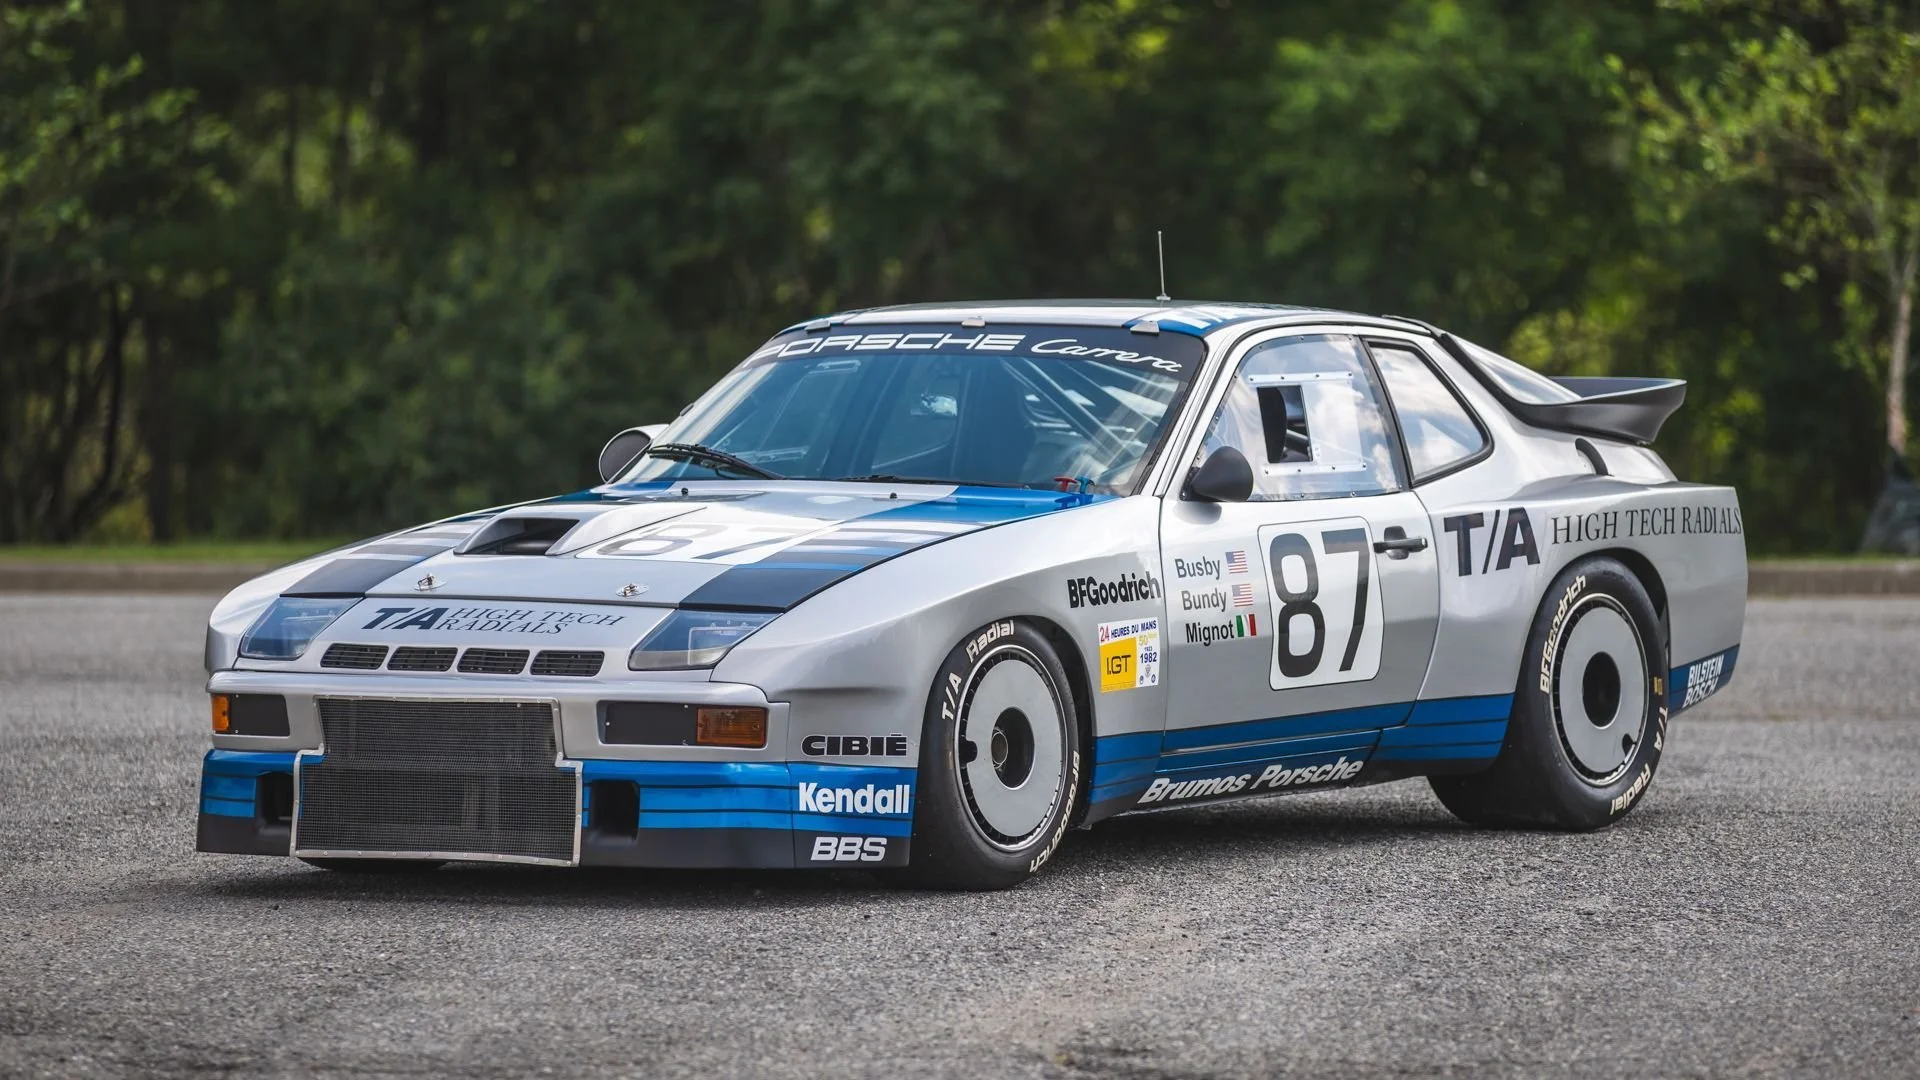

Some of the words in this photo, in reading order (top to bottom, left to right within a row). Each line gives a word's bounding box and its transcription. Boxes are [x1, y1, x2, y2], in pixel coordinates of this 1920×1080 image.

[743, 333, 1025, 368] PORSCHE
[1030, 338, 1182, 374] Carrera
[1444, 506, 1540, 576] T/A
[1551, 510, 1619, 545] HIGH
[1625, 507, 1675, 537] TECH
[1682, 506, 1742, 535] RADIALS
[1175, 556, 1221, 579] Busby
[1067, 571, 1161, 609] BFGoodrich
[1181, 588, 1227, 613] Bundy
[1269, 527, 1370, 678] 87
[361, 607, 450, 630] T/A
[449, 607, 534, 621] HIGH
[538, 610, 625, 626] TECH
[435, 618, 568, 635] RADIALS
[1099, 625, 1110, 642] 24
[1111, 626, 1130, 639] HEURES
[1131, 624, 1139, 634] DU
[1140, 620, 1157, 632] MANS
[1185, 620, 1235, 647] Mignot
[942, 672, 963, 722] T/A
[966, 620, 1015, 662] Radial
[1140, 652, 1158, 664] 1982
[1687, 654, 1724, 688] BILSTEIN
[1682, 676, 1719, 709] BOSCH
[801, 734, 908, 757] CIBIÉ
[1137, 777, 1251, 804] Brumos
[1249, 756, 1365, 790] Porsche
[799, 782, 910, 814] Kendall
[810, 836, 887, 861] BBS
